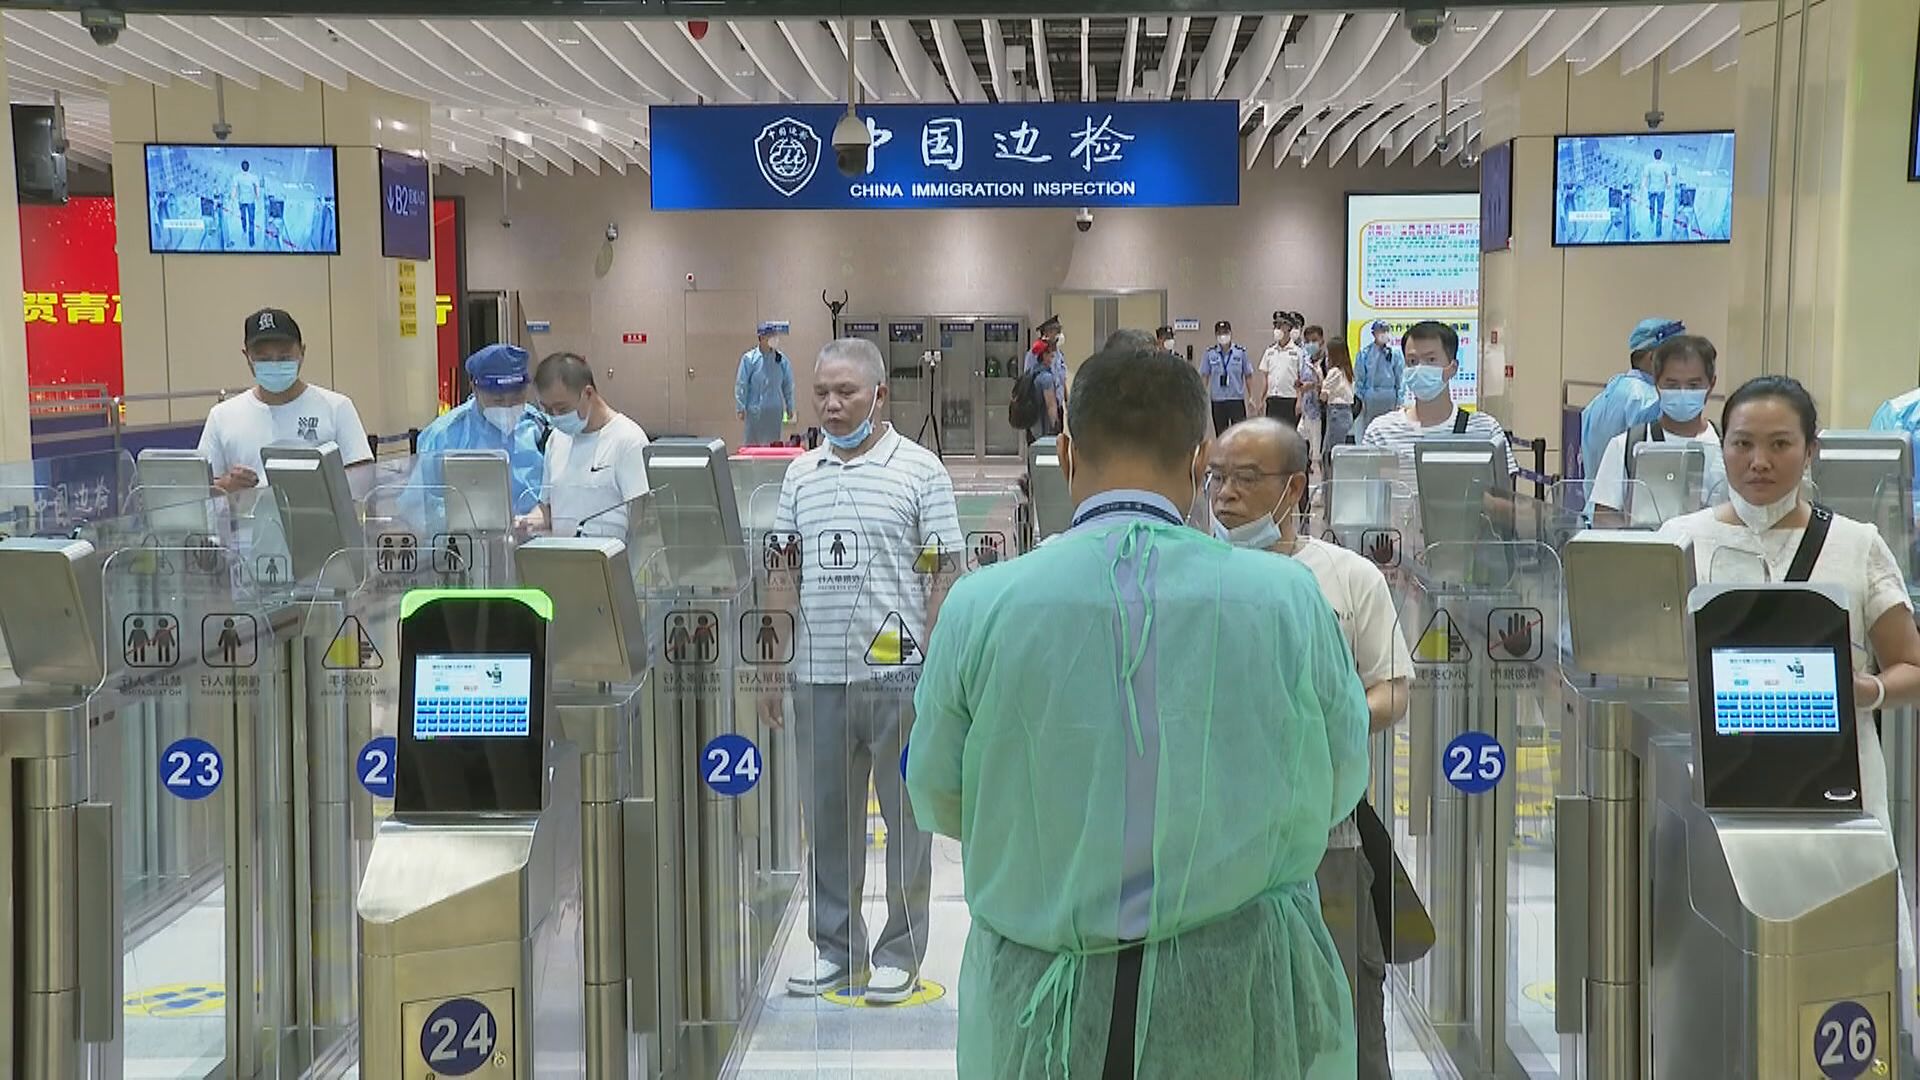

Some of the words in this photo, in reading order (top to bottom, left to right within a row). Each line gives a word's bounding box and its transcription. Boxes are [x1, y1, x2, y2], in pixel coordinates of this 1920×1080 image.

[850, 183, 903, 197] CHINA
[912, 182, 1023, 197] IMMIGRATION
[1034, 181, 1135, 196] INSPECTION
[167, 751, 220, 786] 23
[364, 750, 396, 785] 2
[707, 746, 759, 783] 24
[1449, 744, 1502, 780] 25
[429, 1012, 493, 1062] 24
[1820, 1016, 1872, 1066] 26
